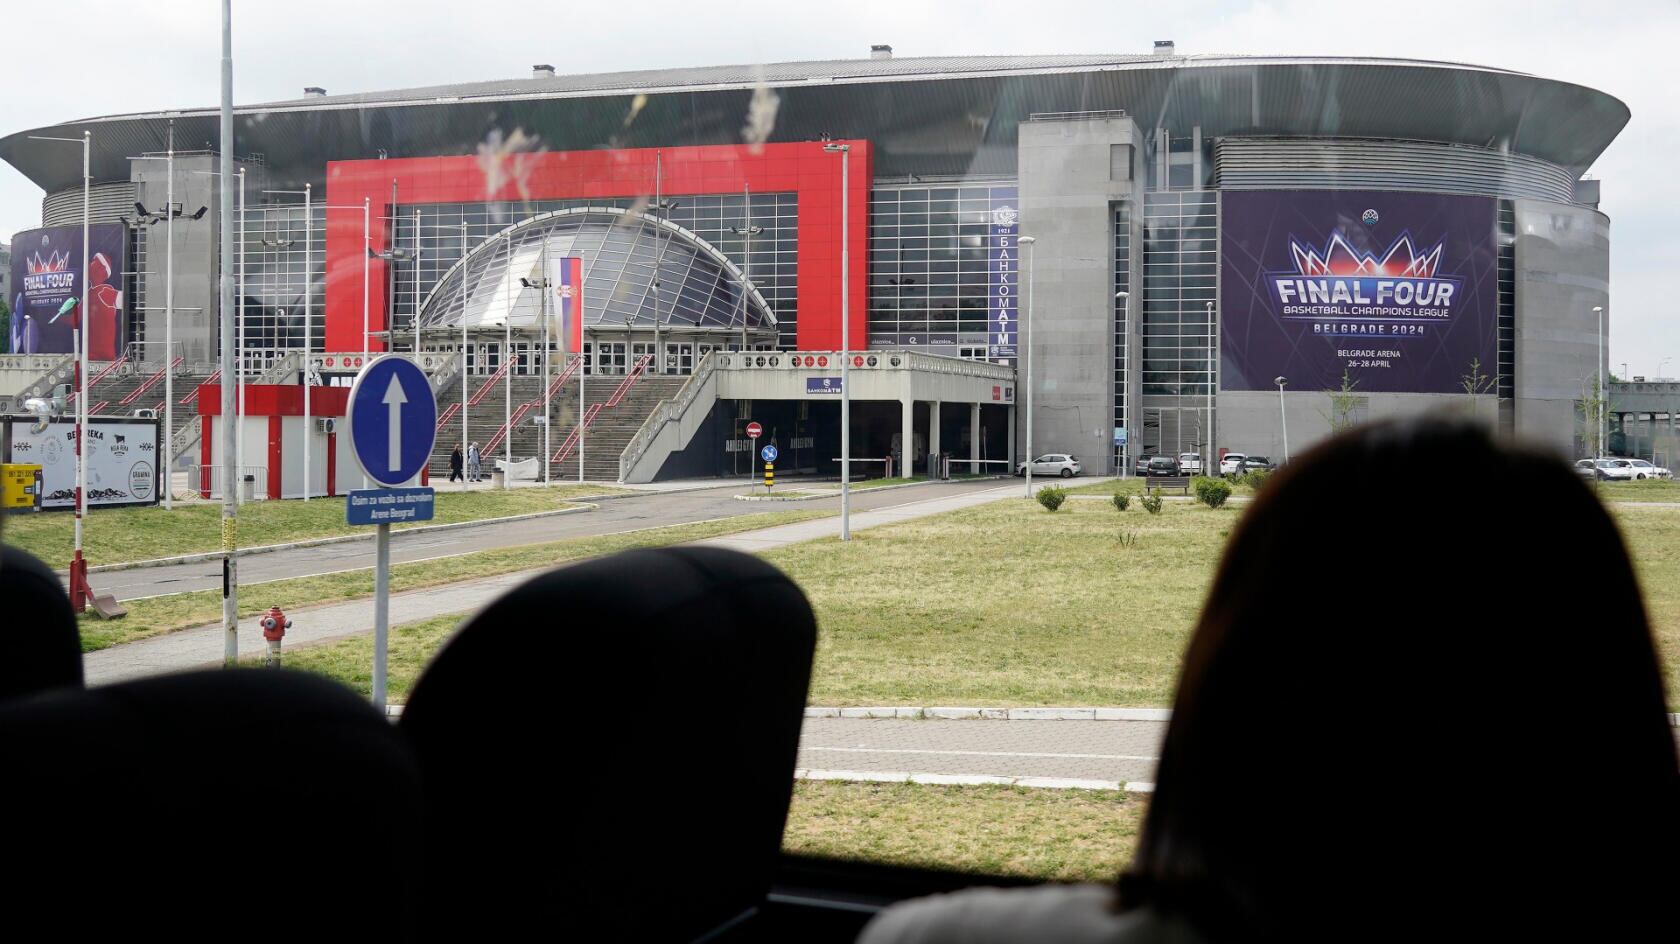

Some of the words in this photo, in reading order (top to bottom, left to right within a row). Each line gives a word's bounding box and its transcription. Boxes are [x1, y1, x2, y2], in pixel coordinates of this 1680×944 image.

[24, 276, 46, 291] FINAL
[46, 273, 74, 289] FOUR
[1276, 280, 1371, 304] FINAL
[1377, 281, 1454, 306] FOUR
[1283, 305, 1350, 315] BASKETBALL
[1351, 306, 1412, 316] CHAMPIONS
[1413, 308, 1449, 317] LEAGUE
[1314, 323, 1384, 334] BELGRADE
[1392, 325, 1424, 335] 2024
[1337, 350, 1375, 358] BELGRADE
[1377, 350, 1401, 358] ARENA
[352, 495, 368, 506] Osim
[378, 494, 396, 504] vozila
[371, 509, 389, 519] Arene
[390, 507, 415, 519] Beograd
